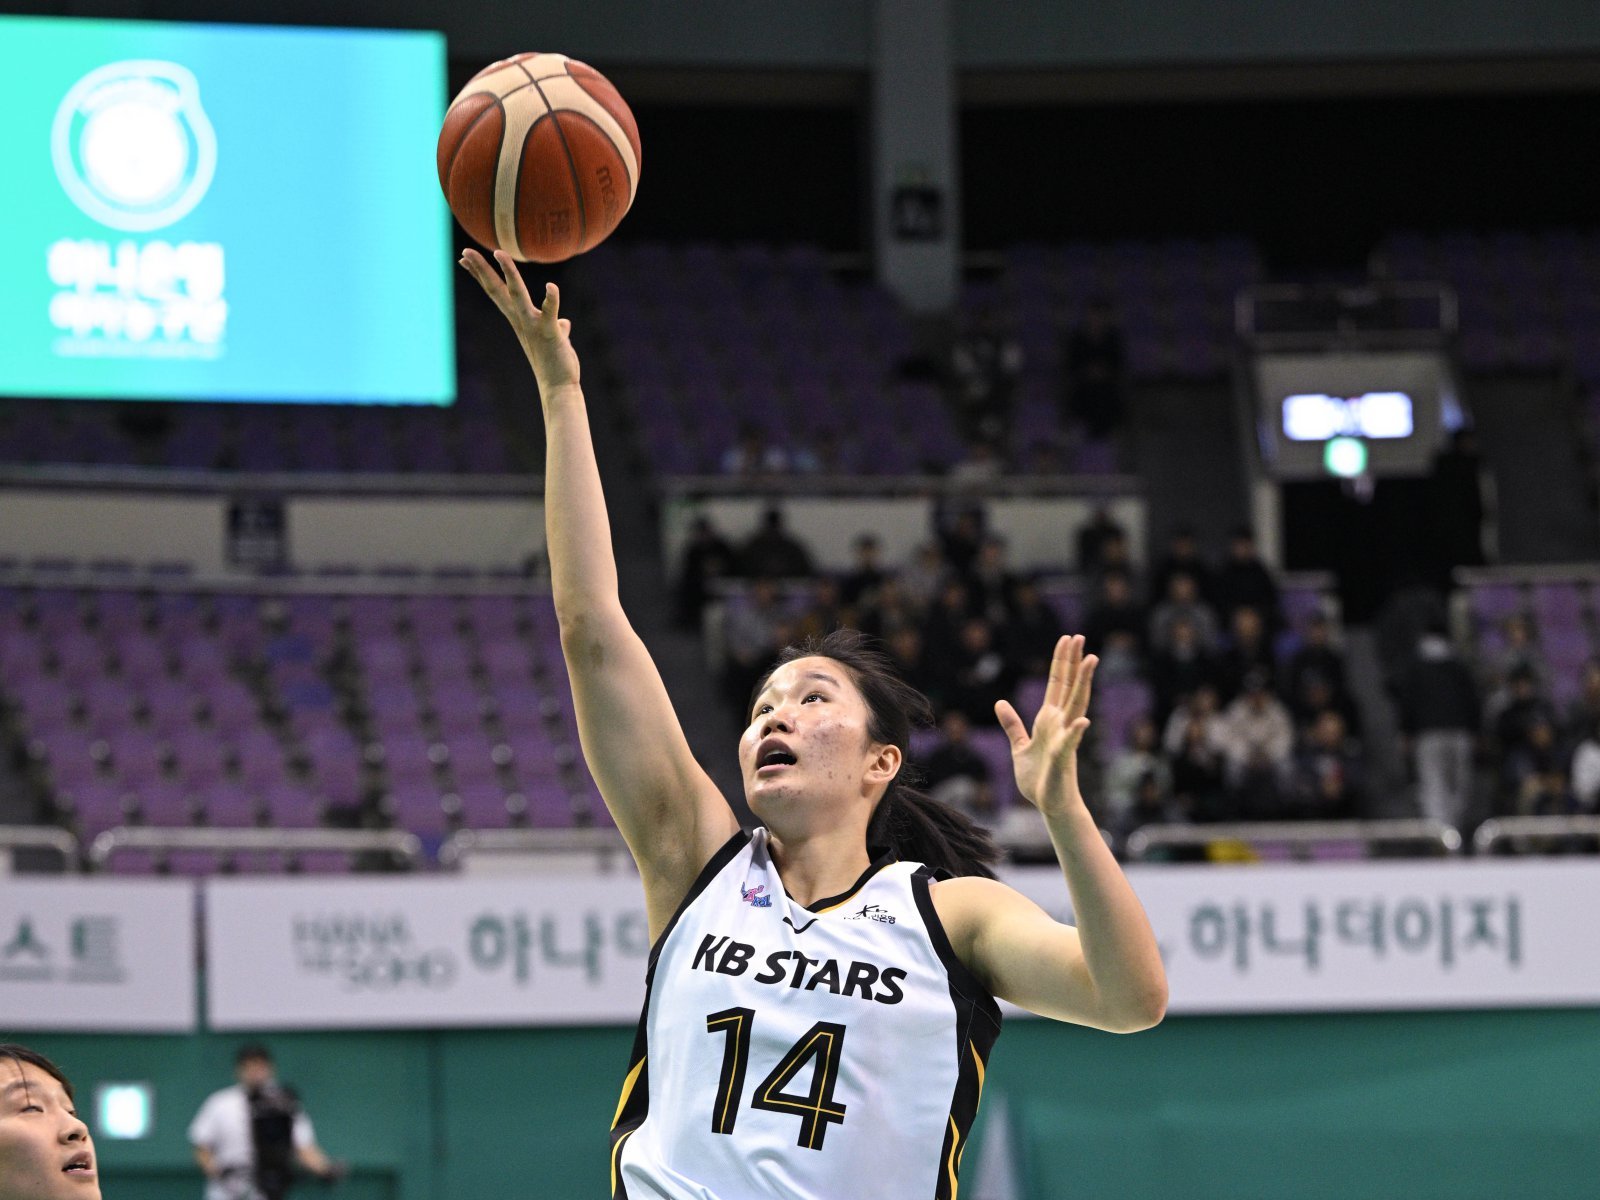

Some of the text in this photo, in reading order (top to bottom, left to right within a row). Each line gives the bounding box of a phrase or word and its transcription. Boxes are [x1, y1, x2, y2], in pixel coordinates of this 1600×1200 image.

[692, 933, 908, 1005] KB STARS
[706, 1006, 847, 1151] 14
